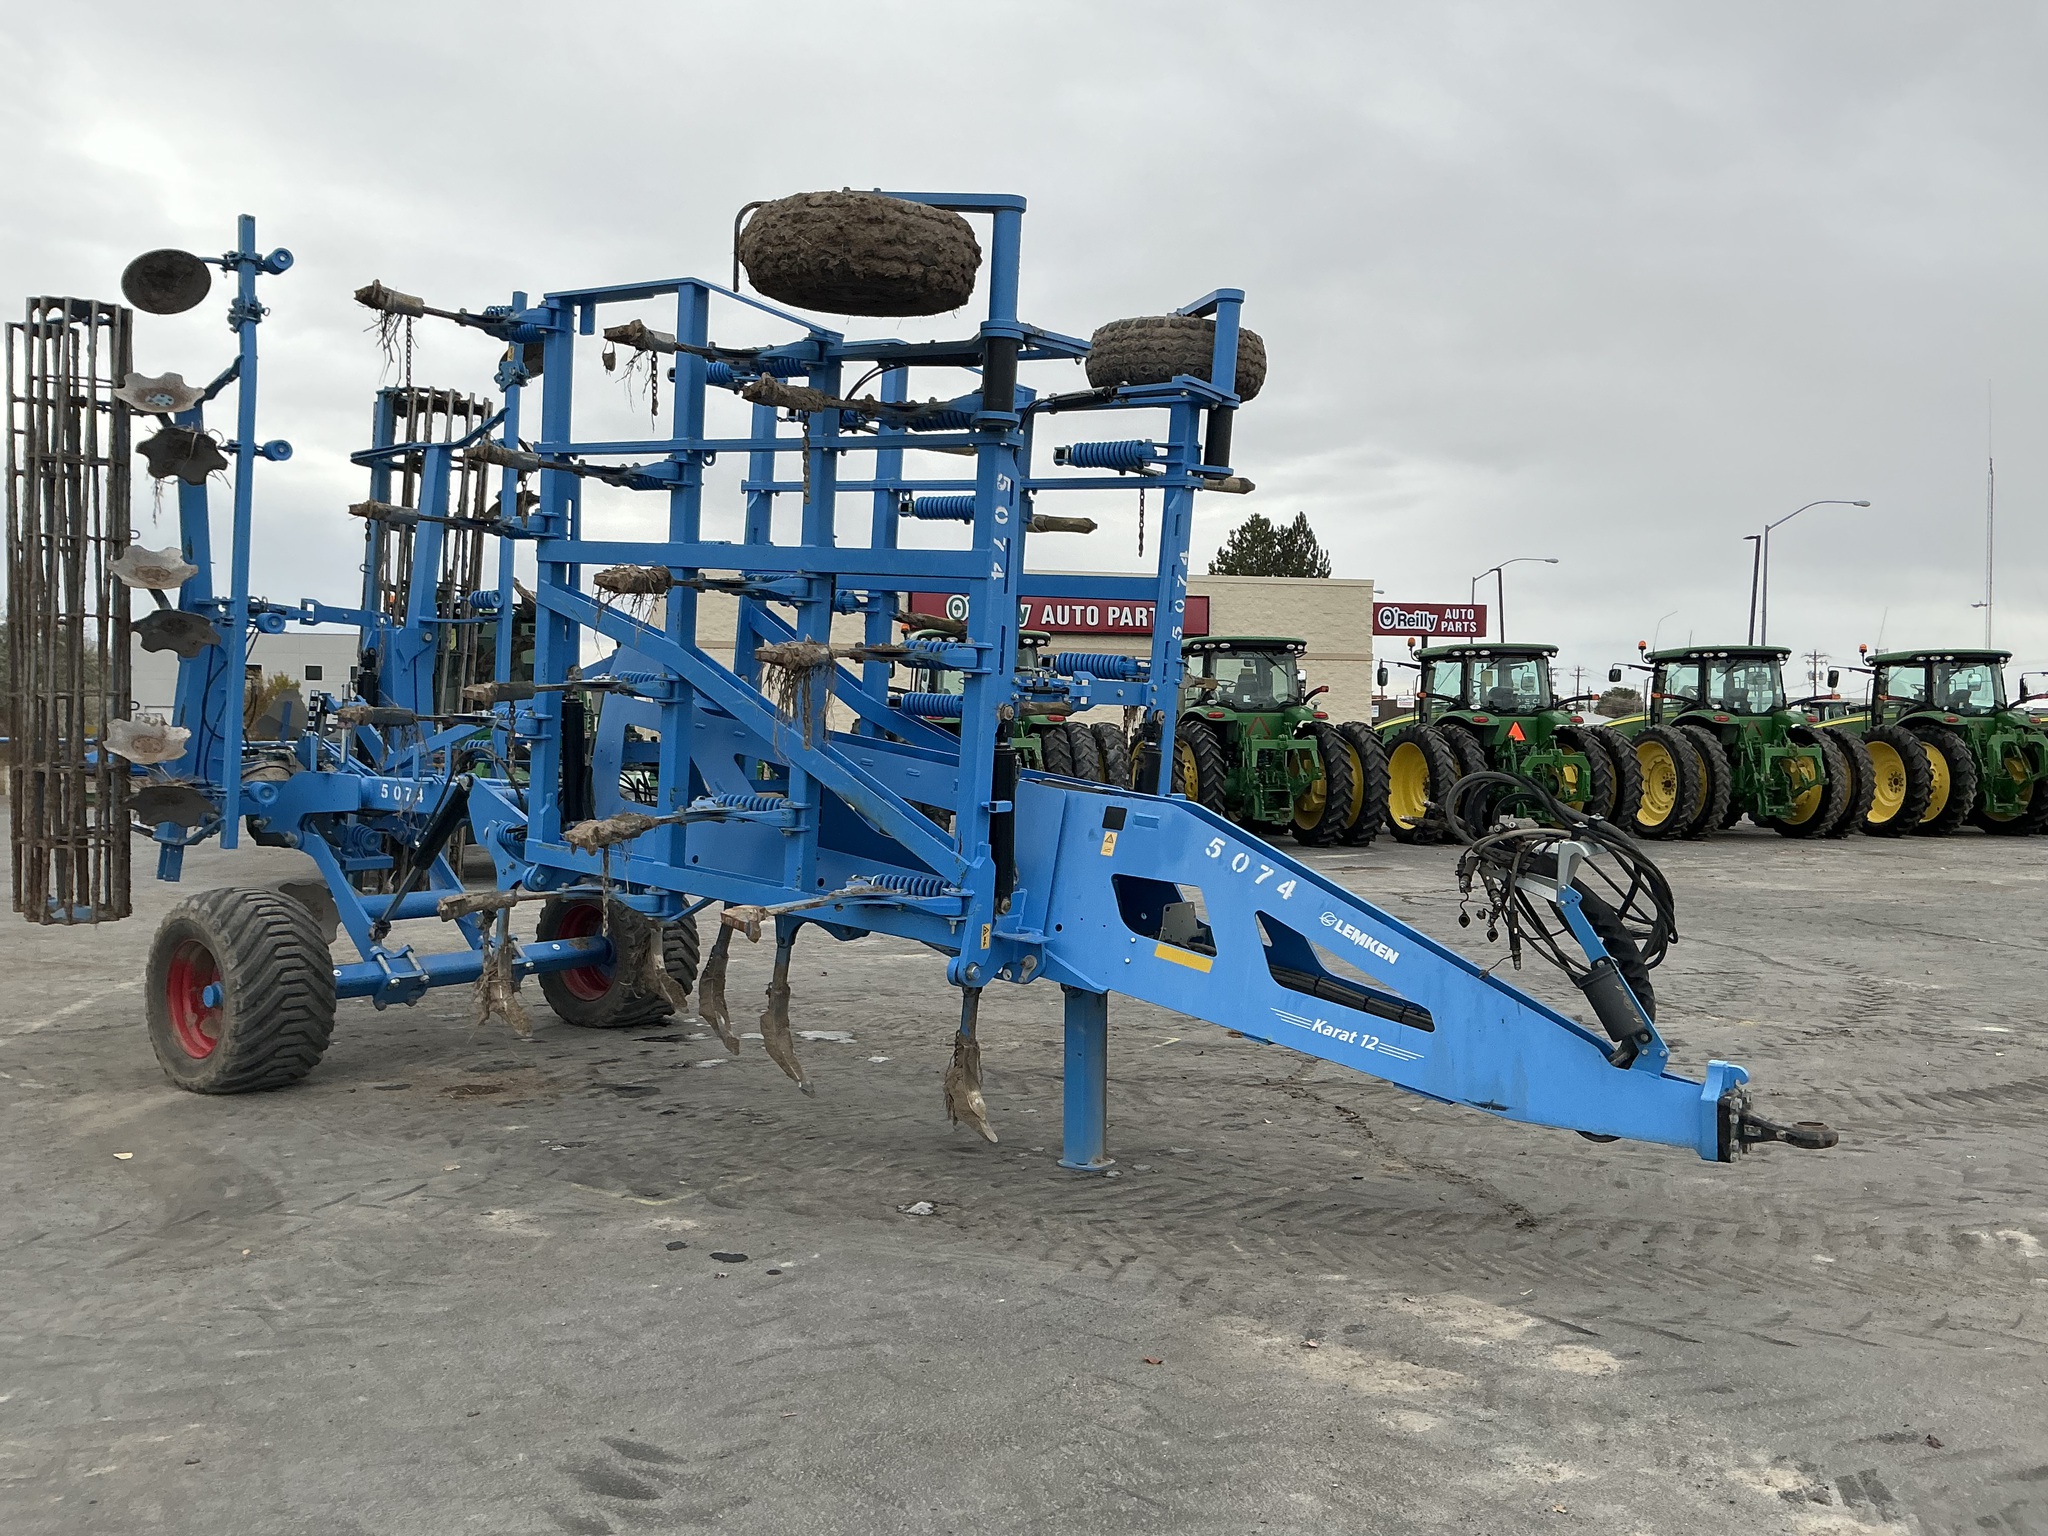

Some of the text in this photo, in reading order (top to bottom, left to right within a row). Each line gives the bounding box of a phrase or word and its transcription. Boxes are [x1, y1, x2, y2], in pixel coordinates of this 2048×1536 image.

[991, 473, 1011, 580] 5074
[1041, 605, 1099, 627] AUTO
[1107, 606, 1156, 627] PART
[1379, 607, 1438, 631] O'Reilly
[1444, 608, 1475, 620] AUTO
[1441, 621, 1477, 633] PARTS
[380, 783, 424, 803] 5074
[1205, 837, 1297, 900] 5074
[1333, 919, 1400, 965] LEMKEN
[1311, 1018, 1379, 1051] Karat 12
